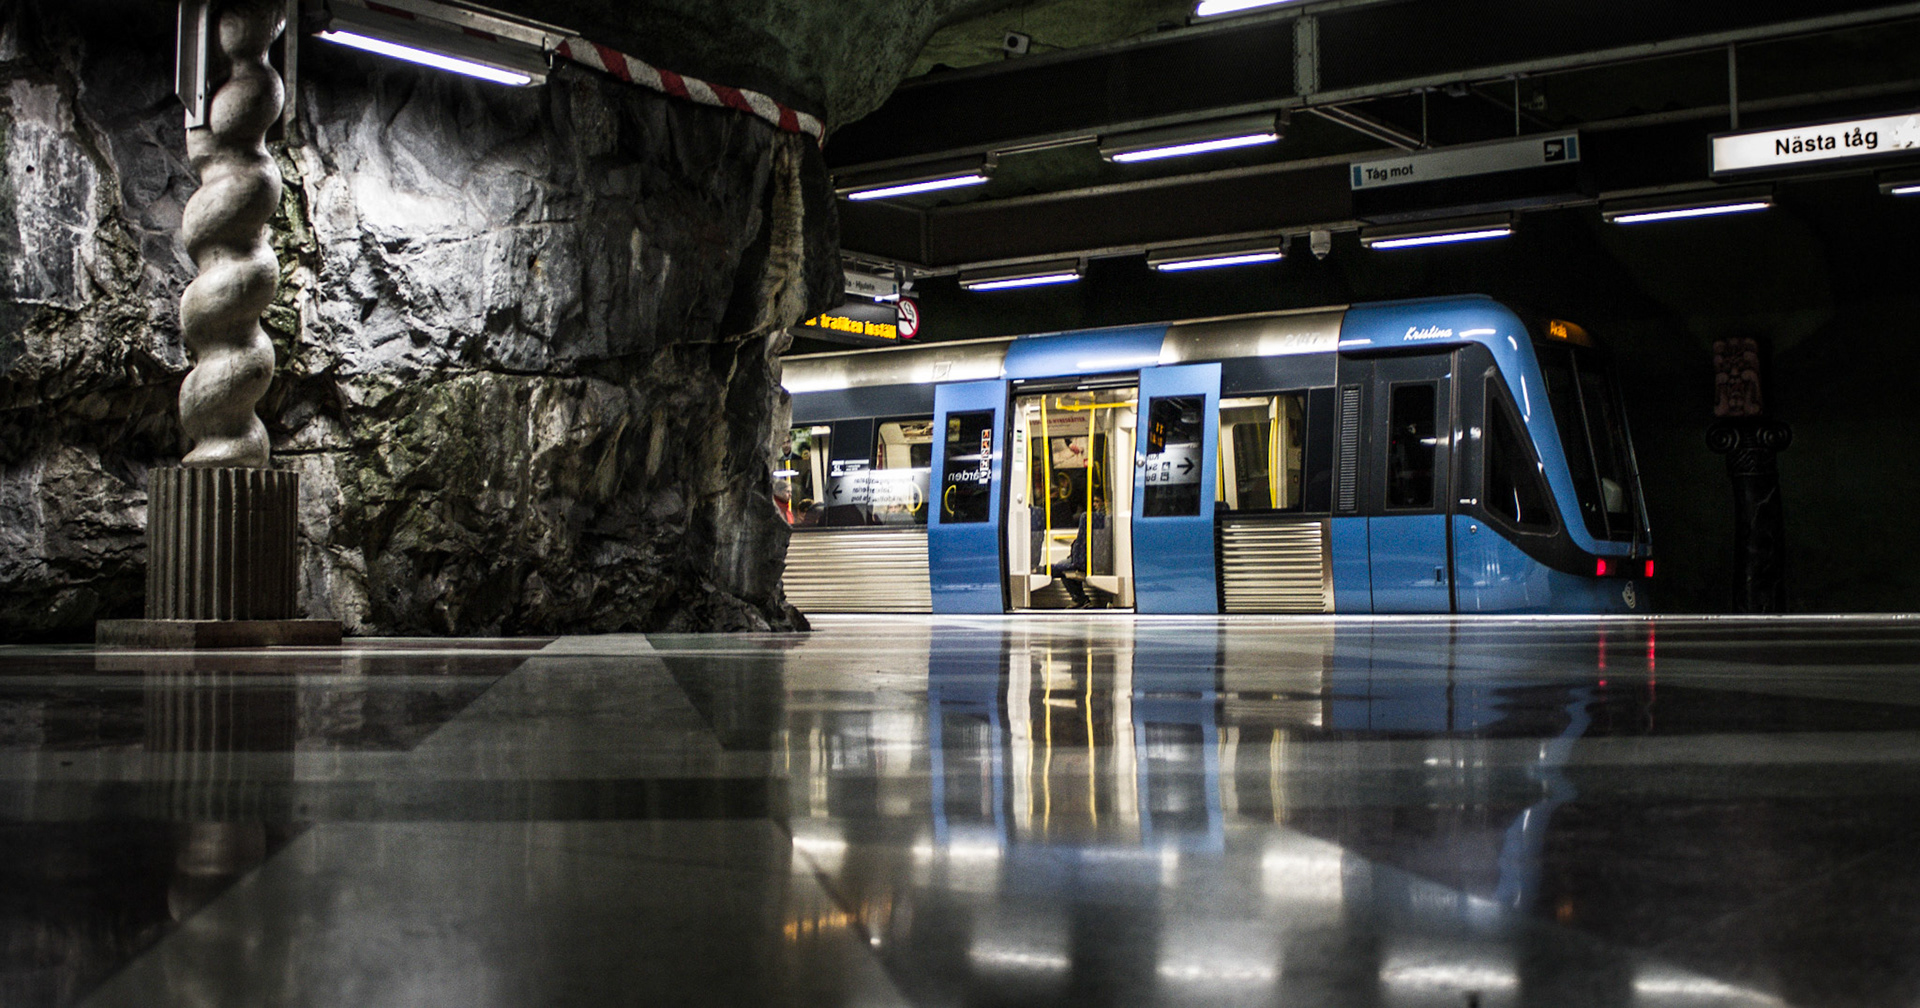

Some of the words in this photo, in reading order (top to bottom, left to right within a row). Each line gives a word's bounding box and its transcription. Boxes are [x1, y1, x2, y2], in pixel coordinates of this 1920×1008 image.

[1775, 134, 1836, 155] Nästa
[1844, 127, 1878, 149] tåg
[1365, 168, 1388, 182] Tåg
[1390, 164, 1414, 177] mot
[1403, 325, 1453, 341] Kristina
